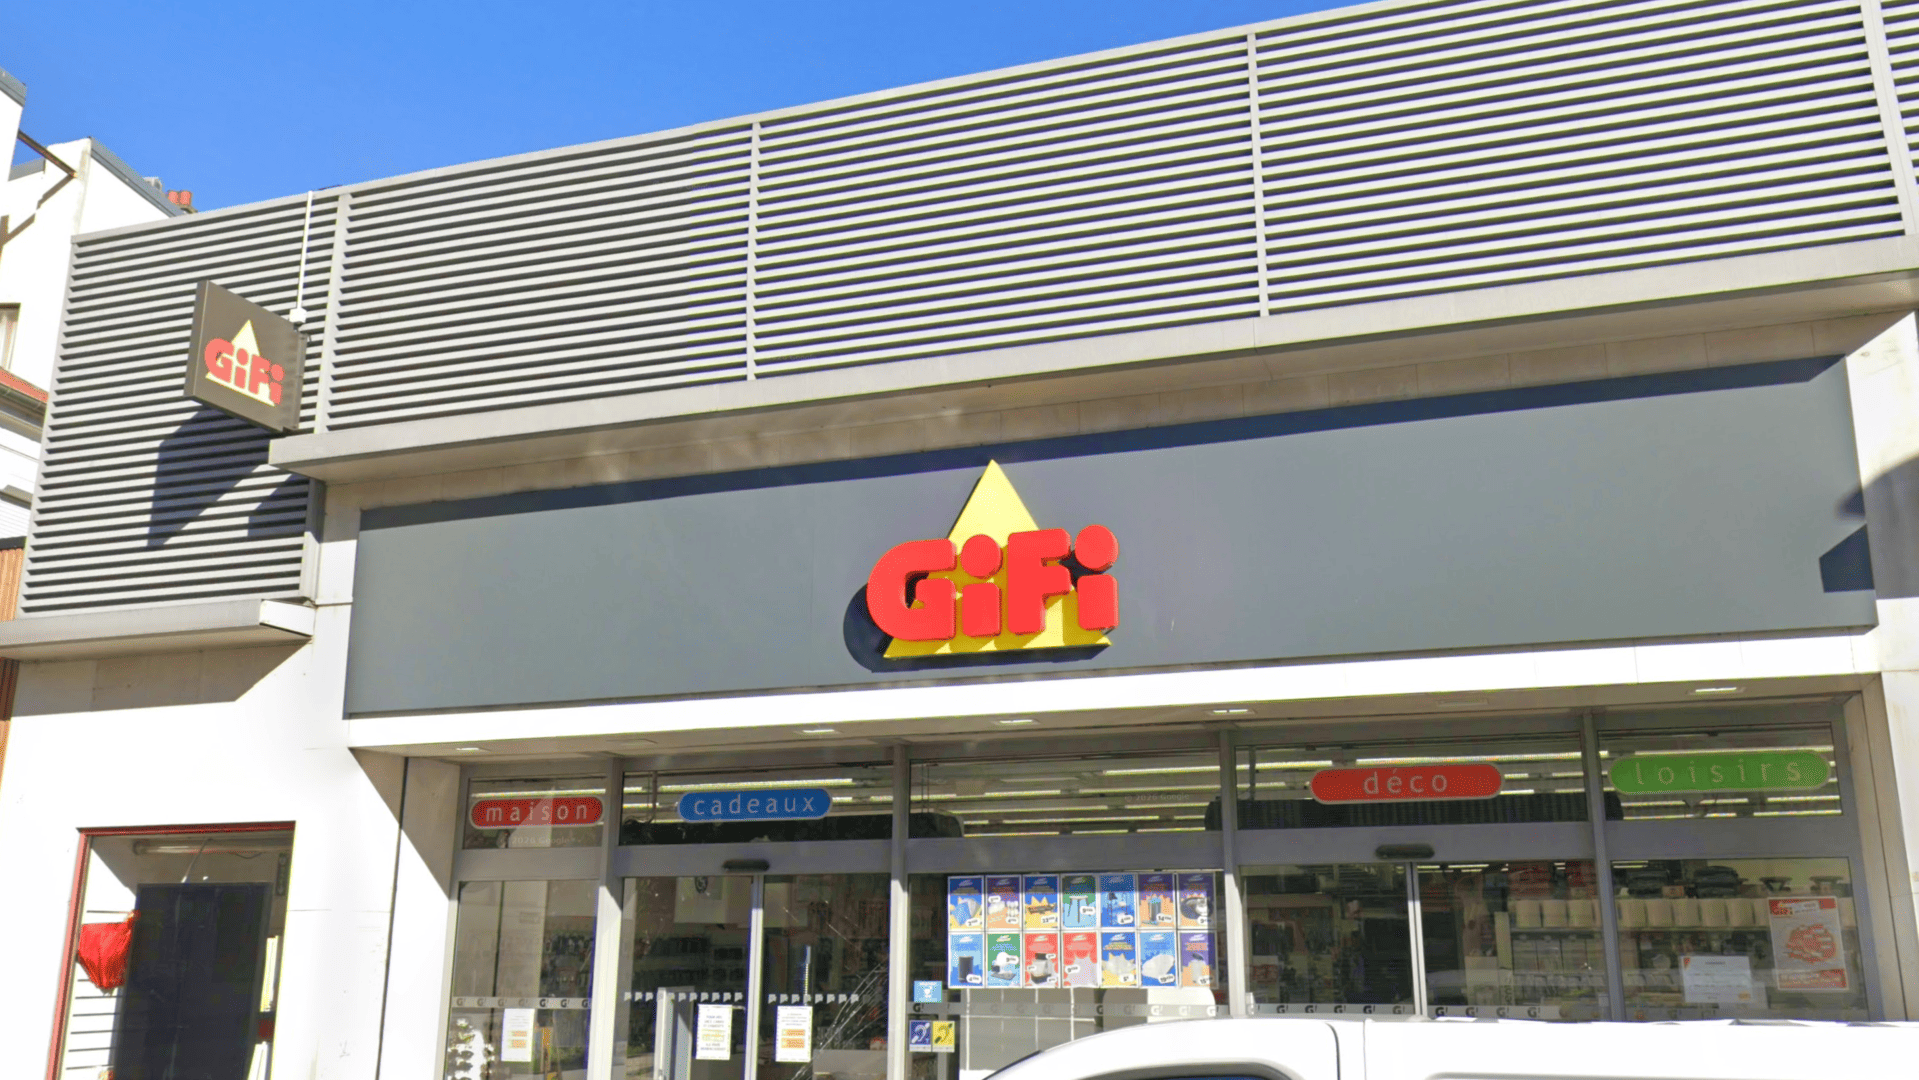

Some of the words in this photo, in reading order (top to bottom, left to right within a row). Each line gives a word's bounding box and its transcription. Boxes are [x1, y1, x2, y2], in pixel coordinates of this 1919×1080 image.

[204, 338, 285, 405] GiFi
[866, 523, 1119, 641] GiFi
[1363, 767, 1448, 795] déco
[1635, 758, 1801, 785] loisirs
[486, 801, 587, 822] maison
[694, 793, 814, 816] cadeaux
